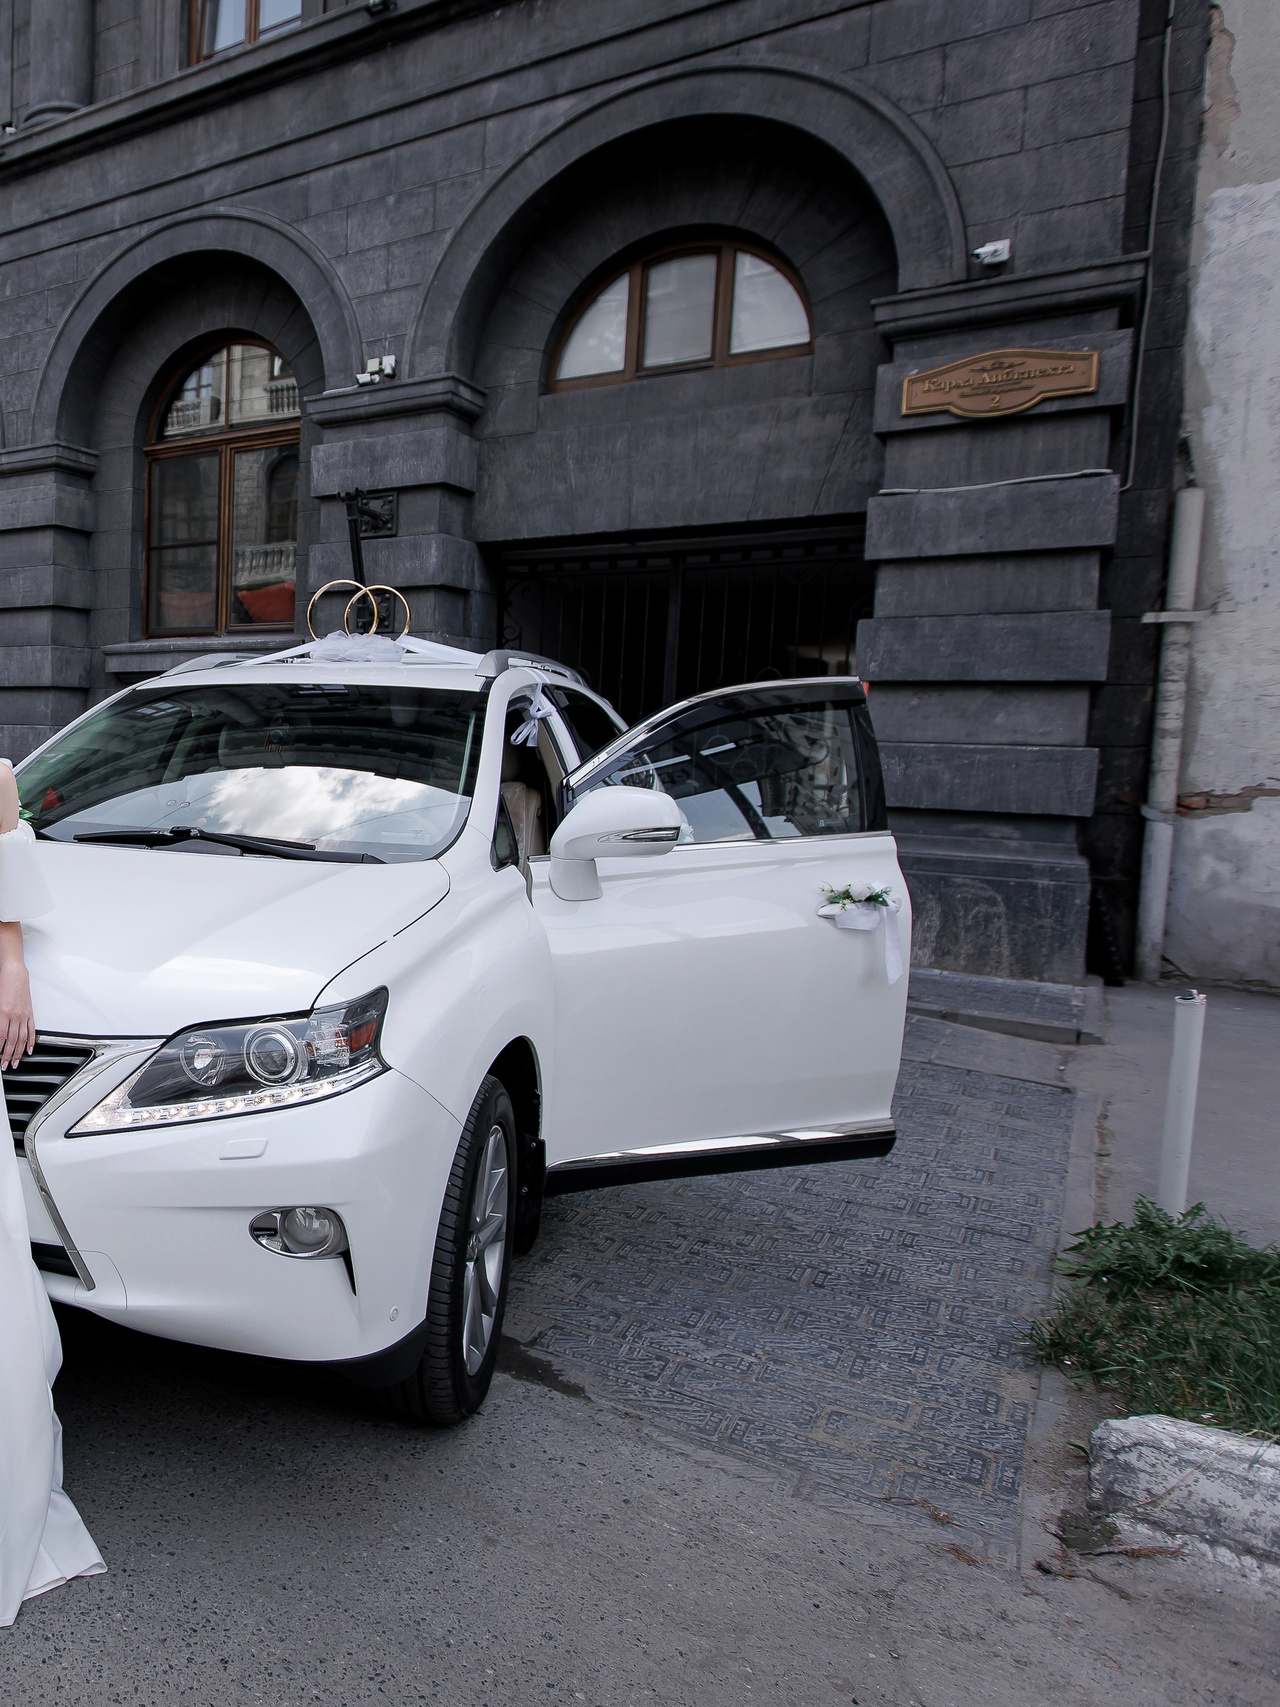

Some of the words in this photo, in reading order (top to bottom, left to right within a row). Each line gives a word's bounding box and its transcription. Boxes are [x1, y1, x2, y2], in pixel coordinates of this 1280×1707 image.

[923, 377, 974, 393] Карла
[979, 364, 1075, 384] Либкнехта
[989, 394, 1001, 407] 2
